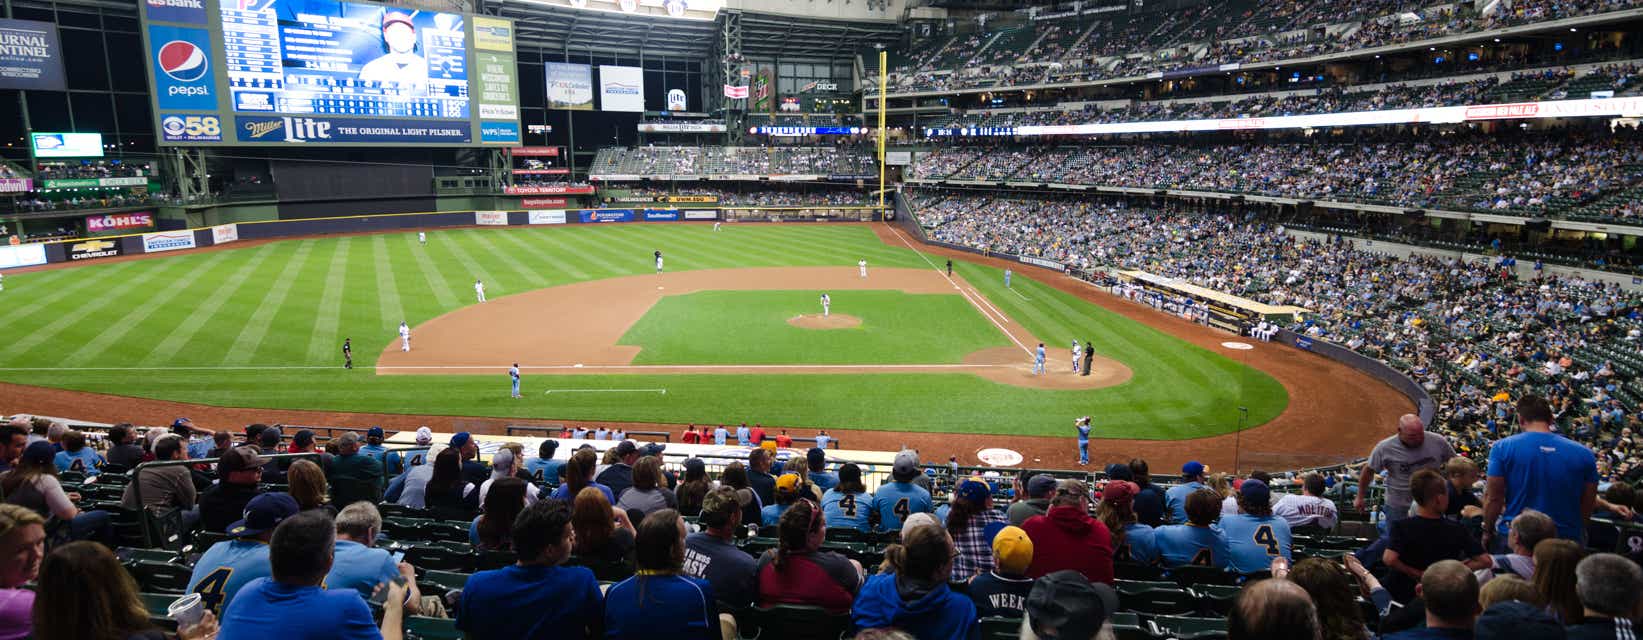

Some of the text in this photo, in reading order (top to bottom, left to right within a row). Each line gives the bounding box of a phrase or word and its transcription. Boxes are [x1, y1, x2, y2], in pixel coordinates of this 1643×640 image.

[168, 85, 207, 96] pepsi
[185, 116, 221, 136] 58
[245, 116, 332, 142] Miller Lite
[338, 127, 358, 135] THE
[359, 127, 401, 136] ORIGINAL
[402, 128, 427, 136] LIGHT
[482, 128, 498, 136] WPS
[89, 216, 150, 228] KOHL'S
[72, 250, 117, 260] CHEVROLET
[838, 493, 857, 519] 4
[893, 497, 911, 522] 4
[1297, 503, 1333, 517] MOLITO
[1253, 523, 1282, 556] 4
[683, 558, 707, 579] ASY,
[193, 566, 234, 621] 4
[989, 593, 1025, 611] WEEK
